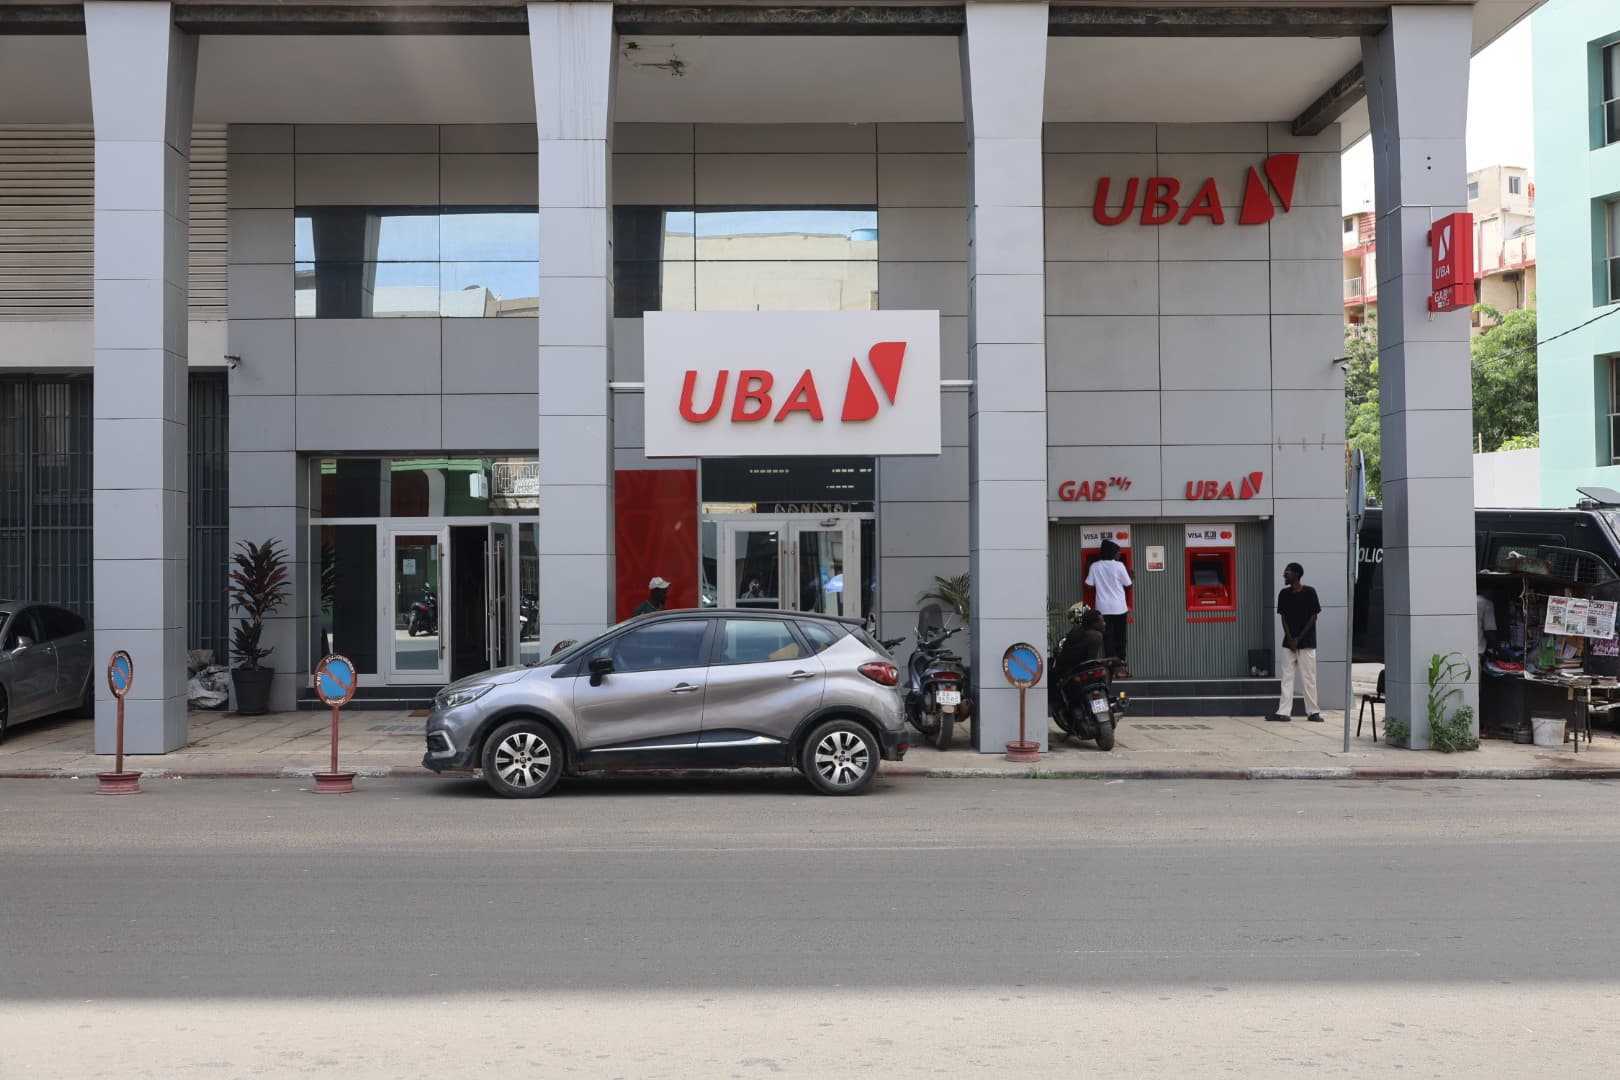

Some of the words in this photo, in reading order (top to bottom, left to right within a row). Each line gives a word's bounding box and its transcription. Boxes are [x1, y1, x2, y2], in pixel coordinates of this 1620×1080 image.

[1093, 176, 1225, 226] UBA
[1436, 264, 1449, 279] UBA
[678, 368, 824, 423] UBA
[1058, 480, 1108, 502] GAB
[1108, 477, 1132, 491] 24/7
[1185, 480, 1236, 501] UBA
[1359, 547, 1383, 563] OLIC
